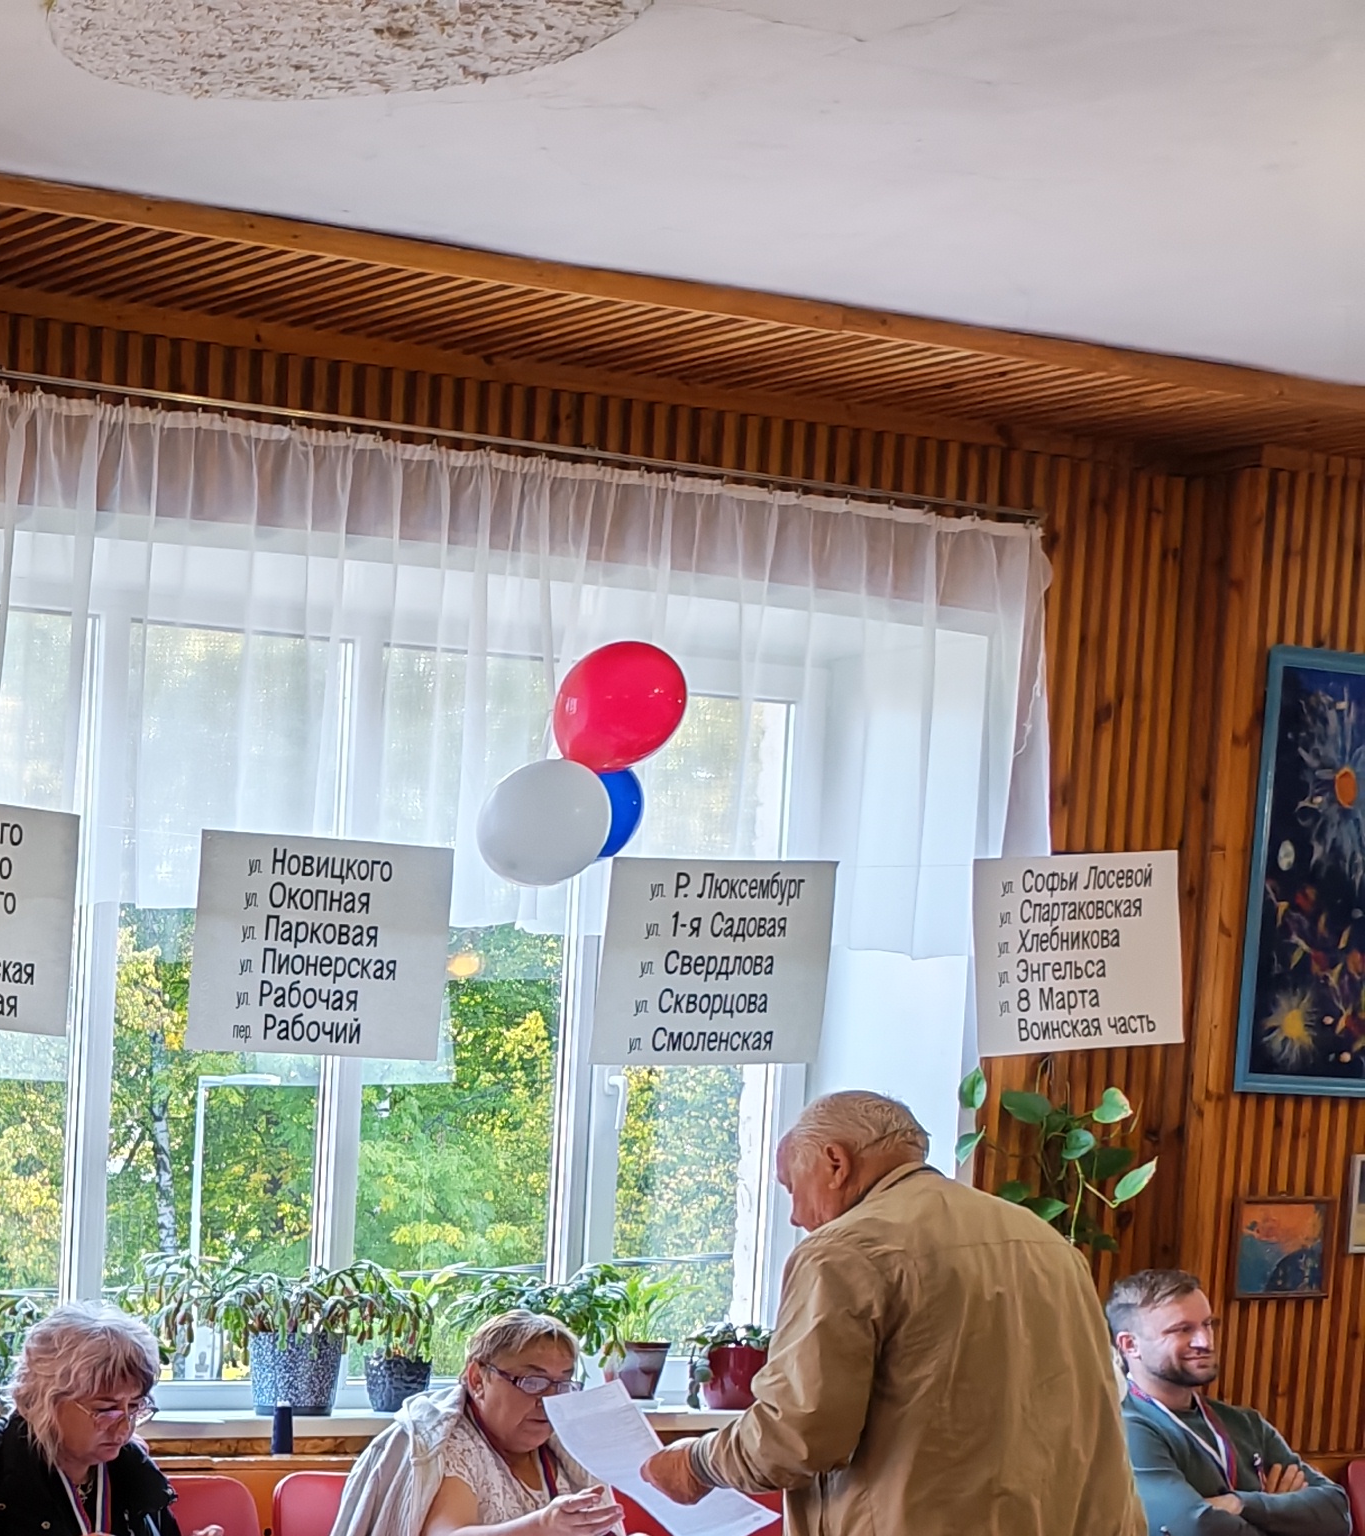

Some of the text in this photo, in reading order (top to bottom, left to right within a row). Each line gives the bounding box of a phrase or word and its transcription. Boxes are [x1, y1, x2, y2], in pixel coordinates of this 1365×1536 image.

[248, 848, 392, 884] ул. Новицкого
[1023, 869, 1078, 897] Софьи
[1083, 863, 1152, 890] Лосевой
[244, 882, 370, 914] ул. Окопная
[650, 872, 805, 906] ул. Р. Люксембург
[644, 911, 787, 942] ул. 1-я Садовая
[1020, 898, 1142, 926] Спартаковская
[241, 915, 378, 948] ул. Парковая
[1017, 926, 1120, 953] Хлебникова
[239, 948, 397, 984] ул. Пионерская
[639, 950, 774, 982] ул. Свердлова
[1017, 959, 1106, 983] Энгельса
[236, 980, 358, 1011] ул. Рабочая
[633, 988, 768, 1020] ул. Скворцова
[1017, 988, 1030, 1012] 8
[1039, 987, 1100, 1015] Марта
[233, 1013, 361, 1044] пер. Рабочий
[628, 1027, 773, 1054] ул. Смоленская
[1018, 1015, 1156, 1041] Воинская часть
